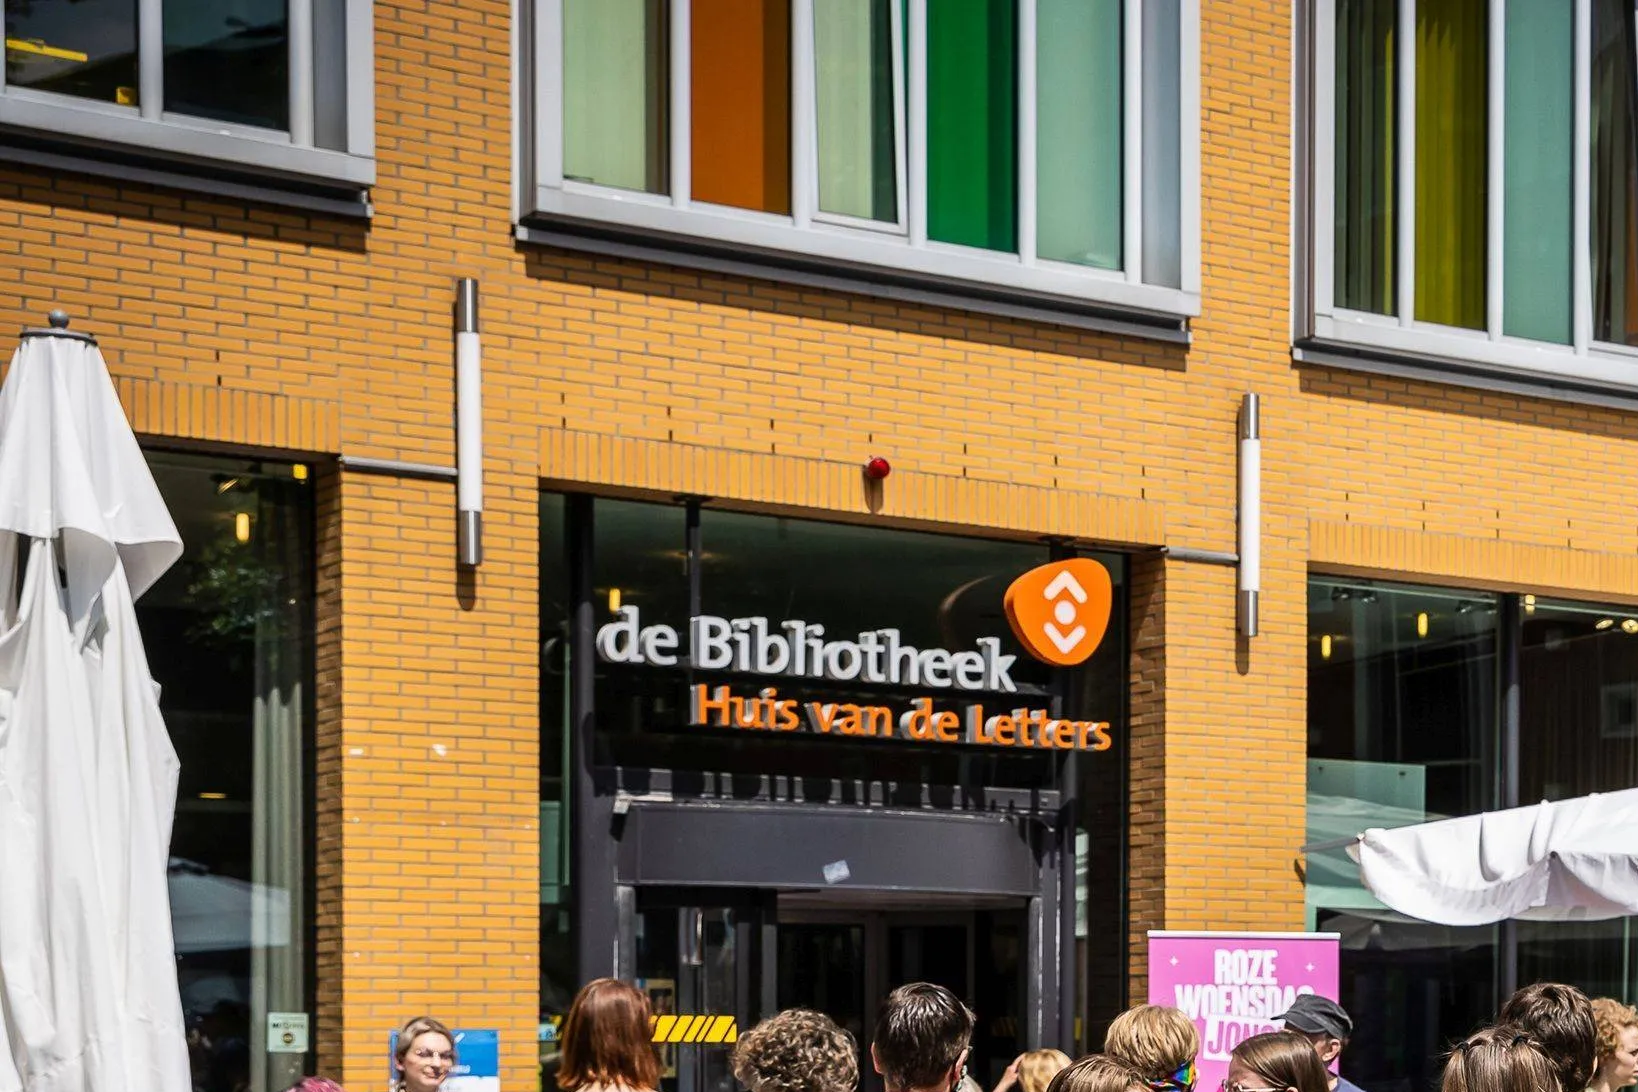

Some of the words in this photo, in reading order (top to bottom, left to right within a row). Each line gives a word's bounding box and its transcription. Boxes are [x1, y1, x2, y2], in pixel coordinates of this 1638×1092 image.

[596, 604, 679, 666] de
[690, 614, 1019, 693] Bibliotheek
[690, 683, 800, 731] Huis
[804, 700, 893, 738] van
[900, 697, 960, 742] de
[966, 704, 1113, 751] Letters
[1214, 949, 1279, 986] ROZE
[1174, 983, 1315, 1020] WOENSDA
